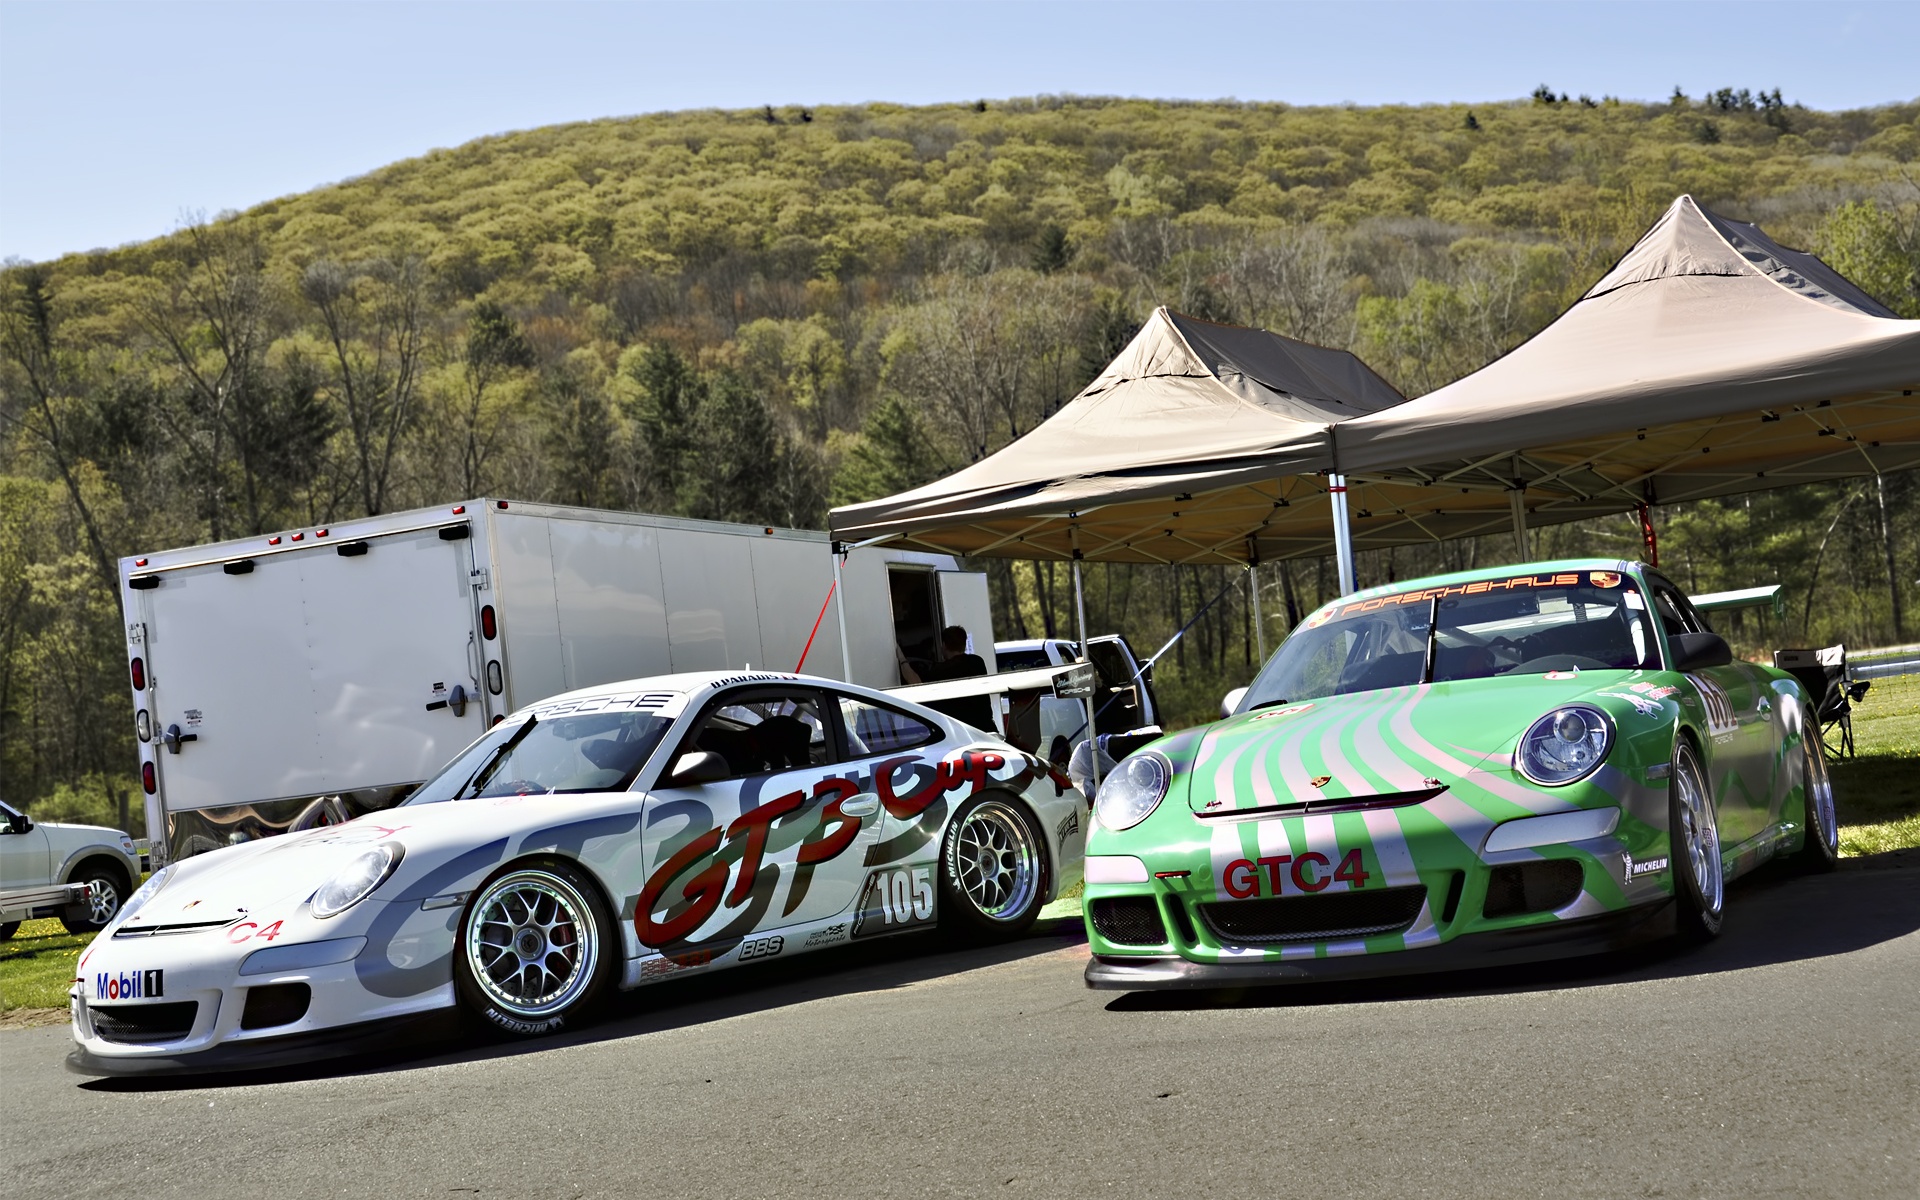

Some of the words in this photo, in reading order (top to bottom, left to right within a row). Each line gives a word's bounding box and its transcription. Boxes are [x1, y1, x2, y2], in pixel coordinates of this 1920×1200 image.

[1341, 573, 1579, 616] PORSCHEHAUS
[634, 777, 862, 949] GT3
[875, 752, 1005, 820] Cup
[946, 821, 958, 877] MICHELIN
[1633, 858, 1668, 874] MICHELIN
[1223, 848, 1370, 899] GTC4
[876, 868, 933, 925] 105
[226, 920, 284, 944] C4
[738, 936, 783, 961] BBS
[97, 970, 142, 1000] Mobil
[148, 970, 159, 996] 1
[485, 1008, 548, 1033] MICHELIN
